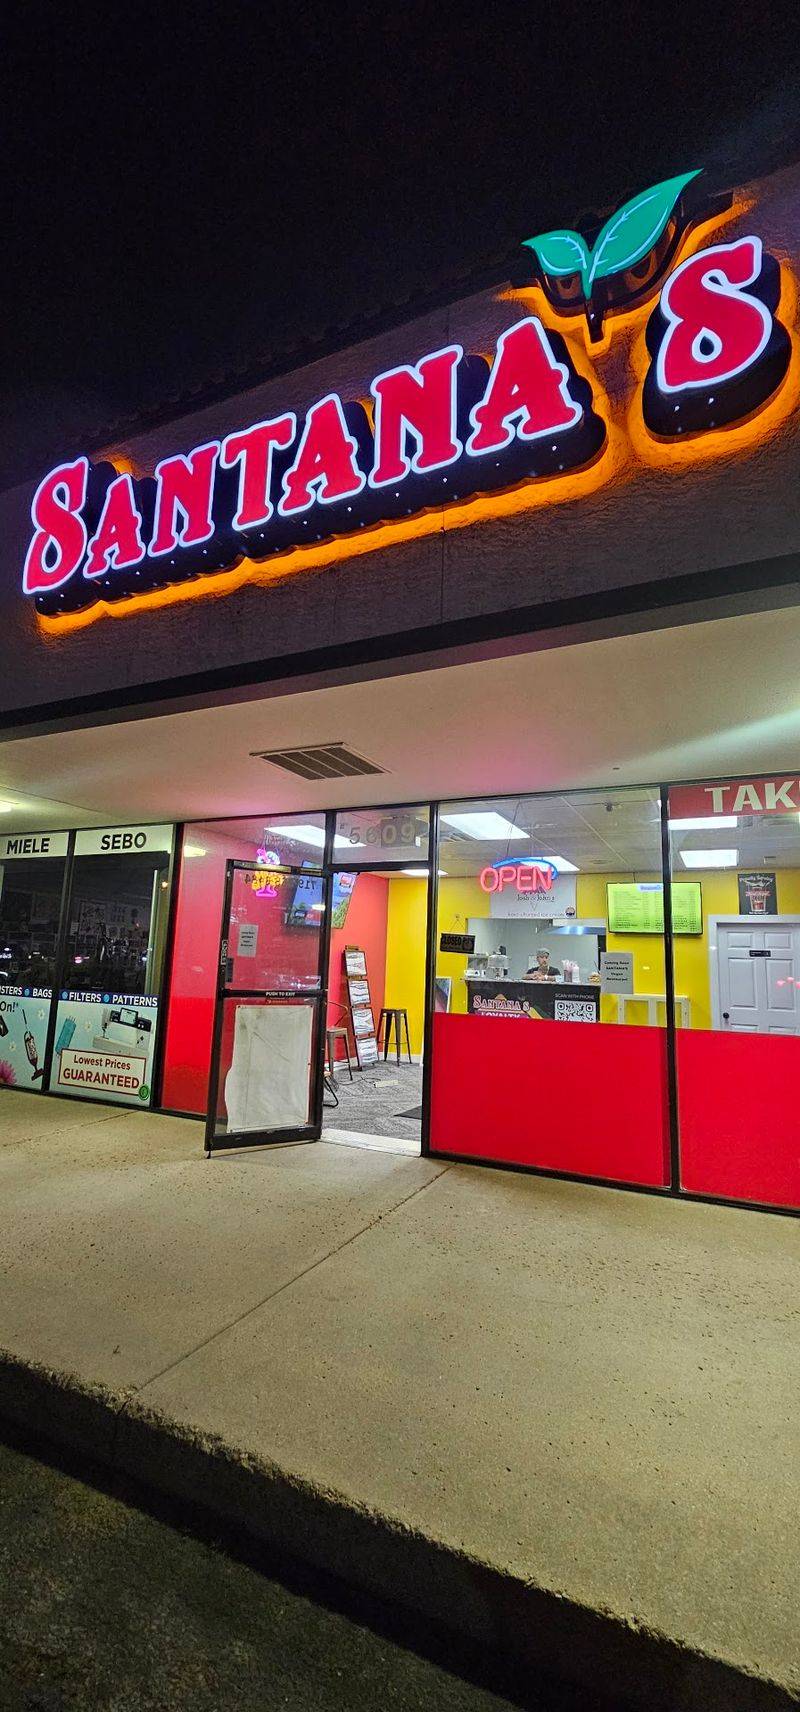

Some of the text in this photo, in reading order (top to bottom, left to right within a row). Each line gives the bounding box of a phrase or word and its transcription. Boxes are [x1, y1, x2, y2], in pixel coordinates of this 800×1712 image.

[704, 780, 800, 813] TAK
[6, 837, 51, 855] MIELE
[100, 831, 147, 851] SEBO
[480, 866, 552, 892] OPEN
[0, 985, 52, 998] STERS BAGS
[68, 991, 158, 1007] FILTERS PATTERNS
[73, 1054, 131, 1071] Lowest Prices
[62, 1067, 140, 1089] GUARANTEED
